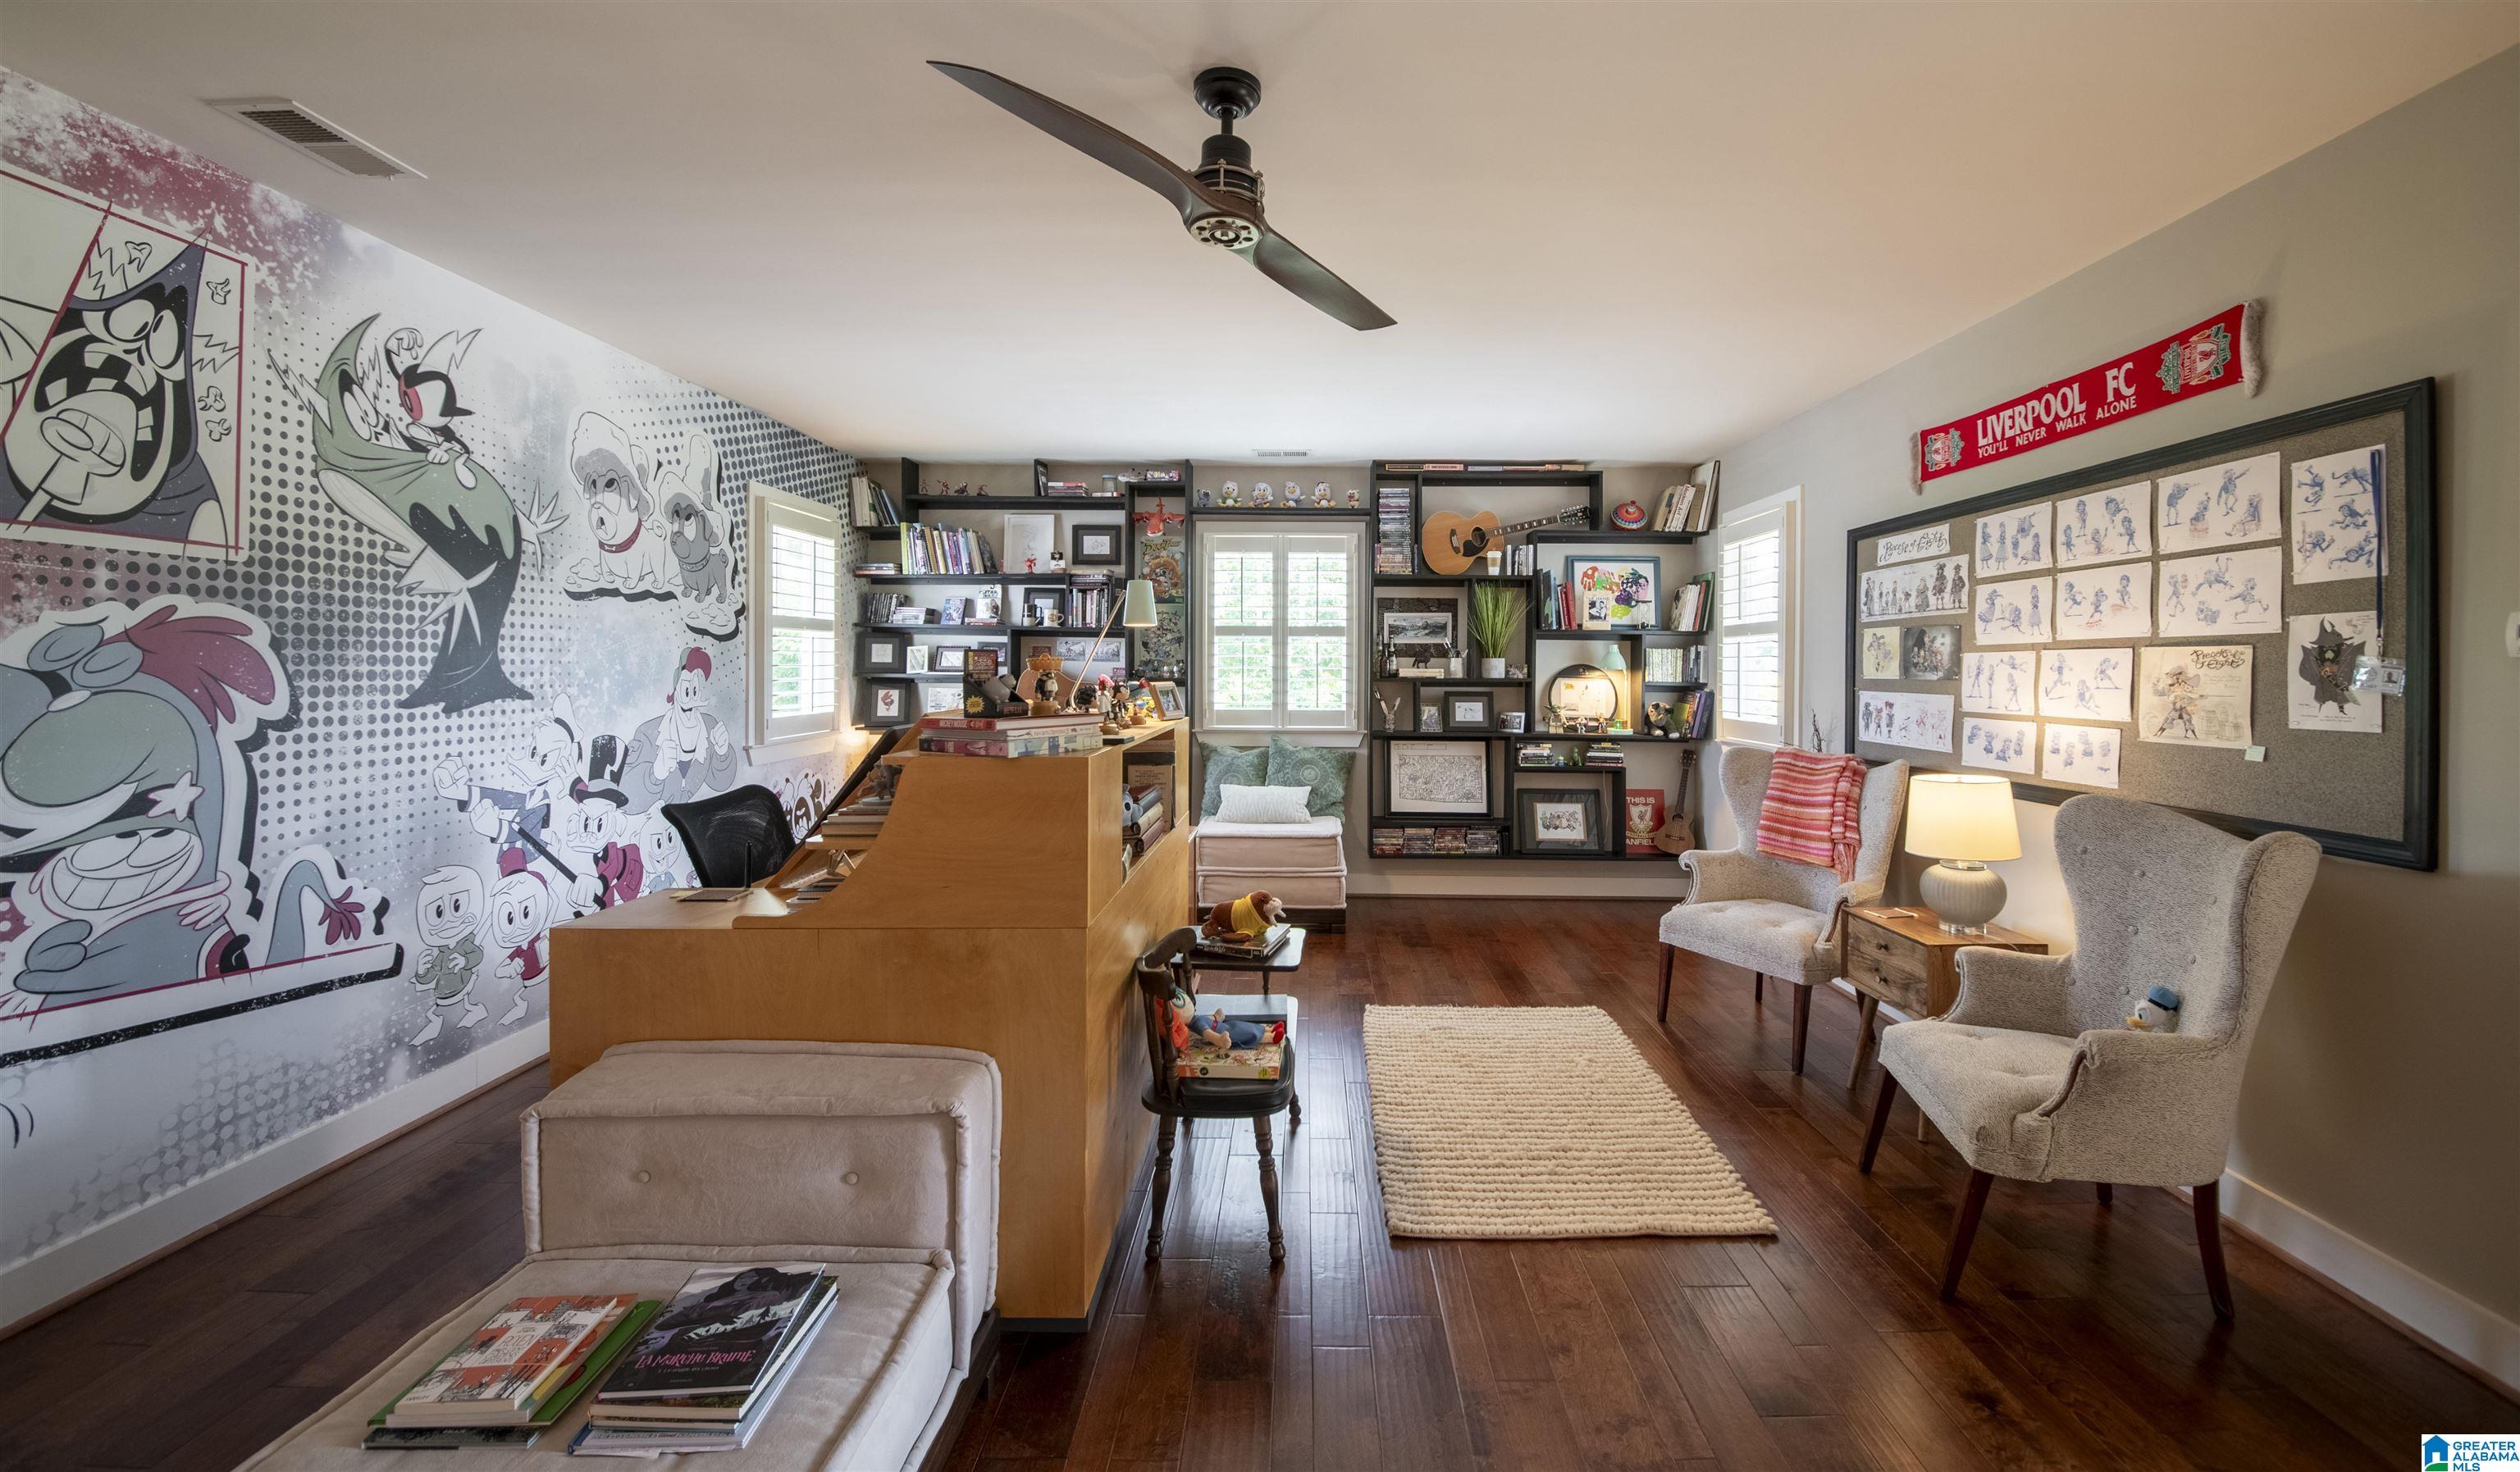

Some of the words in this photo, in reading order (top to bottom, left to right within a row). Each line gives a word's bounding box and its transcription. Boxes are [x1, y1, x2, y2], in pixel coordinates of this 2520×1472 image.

[1977, 382, 2087, 447] LIVERPOOL
[2106, 362, 2136, 403] FC
[1978, 440, 2009, 458] YOU'LL
[2015, 426, 2047, 447] NEVER
[2055, 412, 2087, 433] WALK
[2096, 395, 2137, 420] ALONE
[635, 1354, 653, 1369] LA
